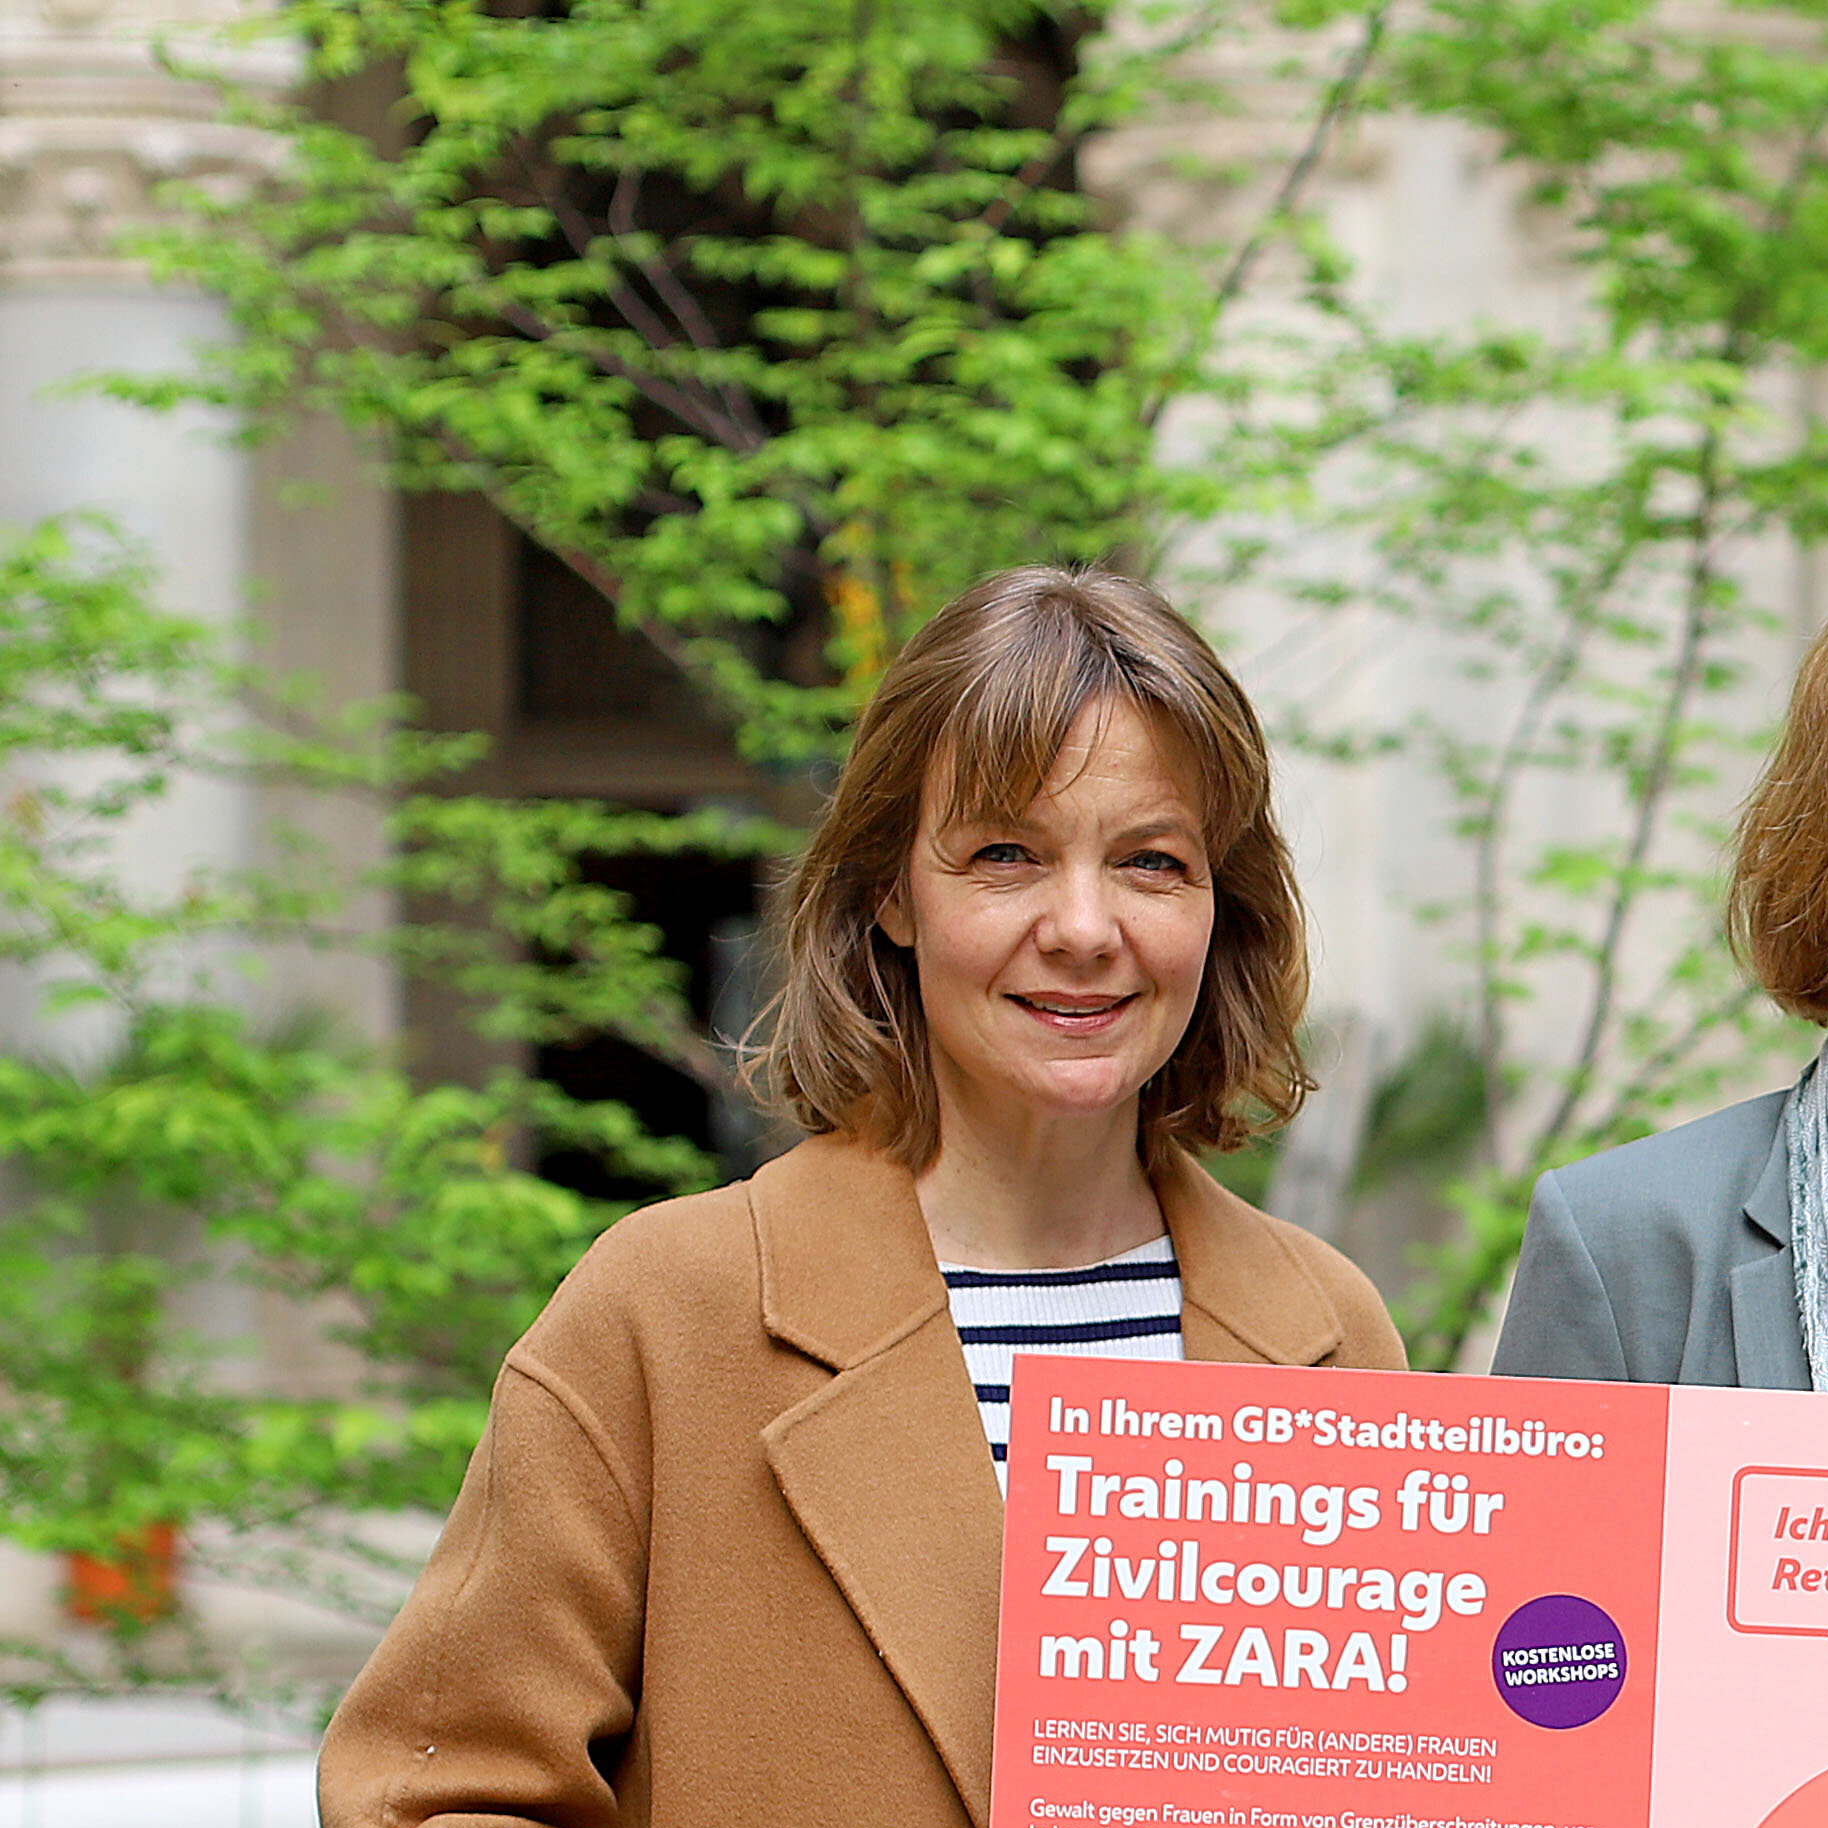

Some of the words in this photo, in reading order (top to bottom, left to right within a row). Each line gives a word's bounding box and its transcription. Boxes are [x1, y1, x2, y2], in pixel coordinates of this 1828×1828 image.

[1050, 1396, 1089, 1434] In
[1100, 1398, 1223, 1441] Ihrem
[1046, 1454, 1381, 1546] Trainings
[1396, 1469, 1504, 1534] für
[1041, 1536, 1487, 1632] Zivilcourage
[1039, 1619, 1161, 1682] mit
[1175, 1624, 1408, 1693] ZARA!
[1502, 1643, 1615, 1667] KOSTENLOSE
[1505, 1662, 1619, 1686] WORKSHOPS
[1034, 1719, 1114, 1741] LERNEN
[1117, 1722, 1151, 1746] SIE,
[1155, 1724, 1202, 1745] SICH
[1205, 1727, 1271, 1748] MUTIG
[1275, 1726, 1315, 1750] FÜR
[1317, 1730, 1413, 1757] (ANDERE)
[1417, 1735, 1497, 1757] FRAUEN
[1033, 1745, 1169, 1769] EINZUSETZEN
[1173, 1751, 1220, 1772] UND
[1223, 1753, 1352, 1777] COURAGIERT
[1354, 1759, 1383, 1779] ZU
[1386, 1761, 1491, 1784] HANDELN!
[1029, 1798, 1096, 1820] Gewalt
[1098, 1806, 1158, 1826] gegen
[1162, 1803, 1225, 1825] Frauen
[1229, 1807, 1247, 1825] in
[1250, 1807, 1298, 1828] Form
[1301, 1815, 1337, 1828] von
